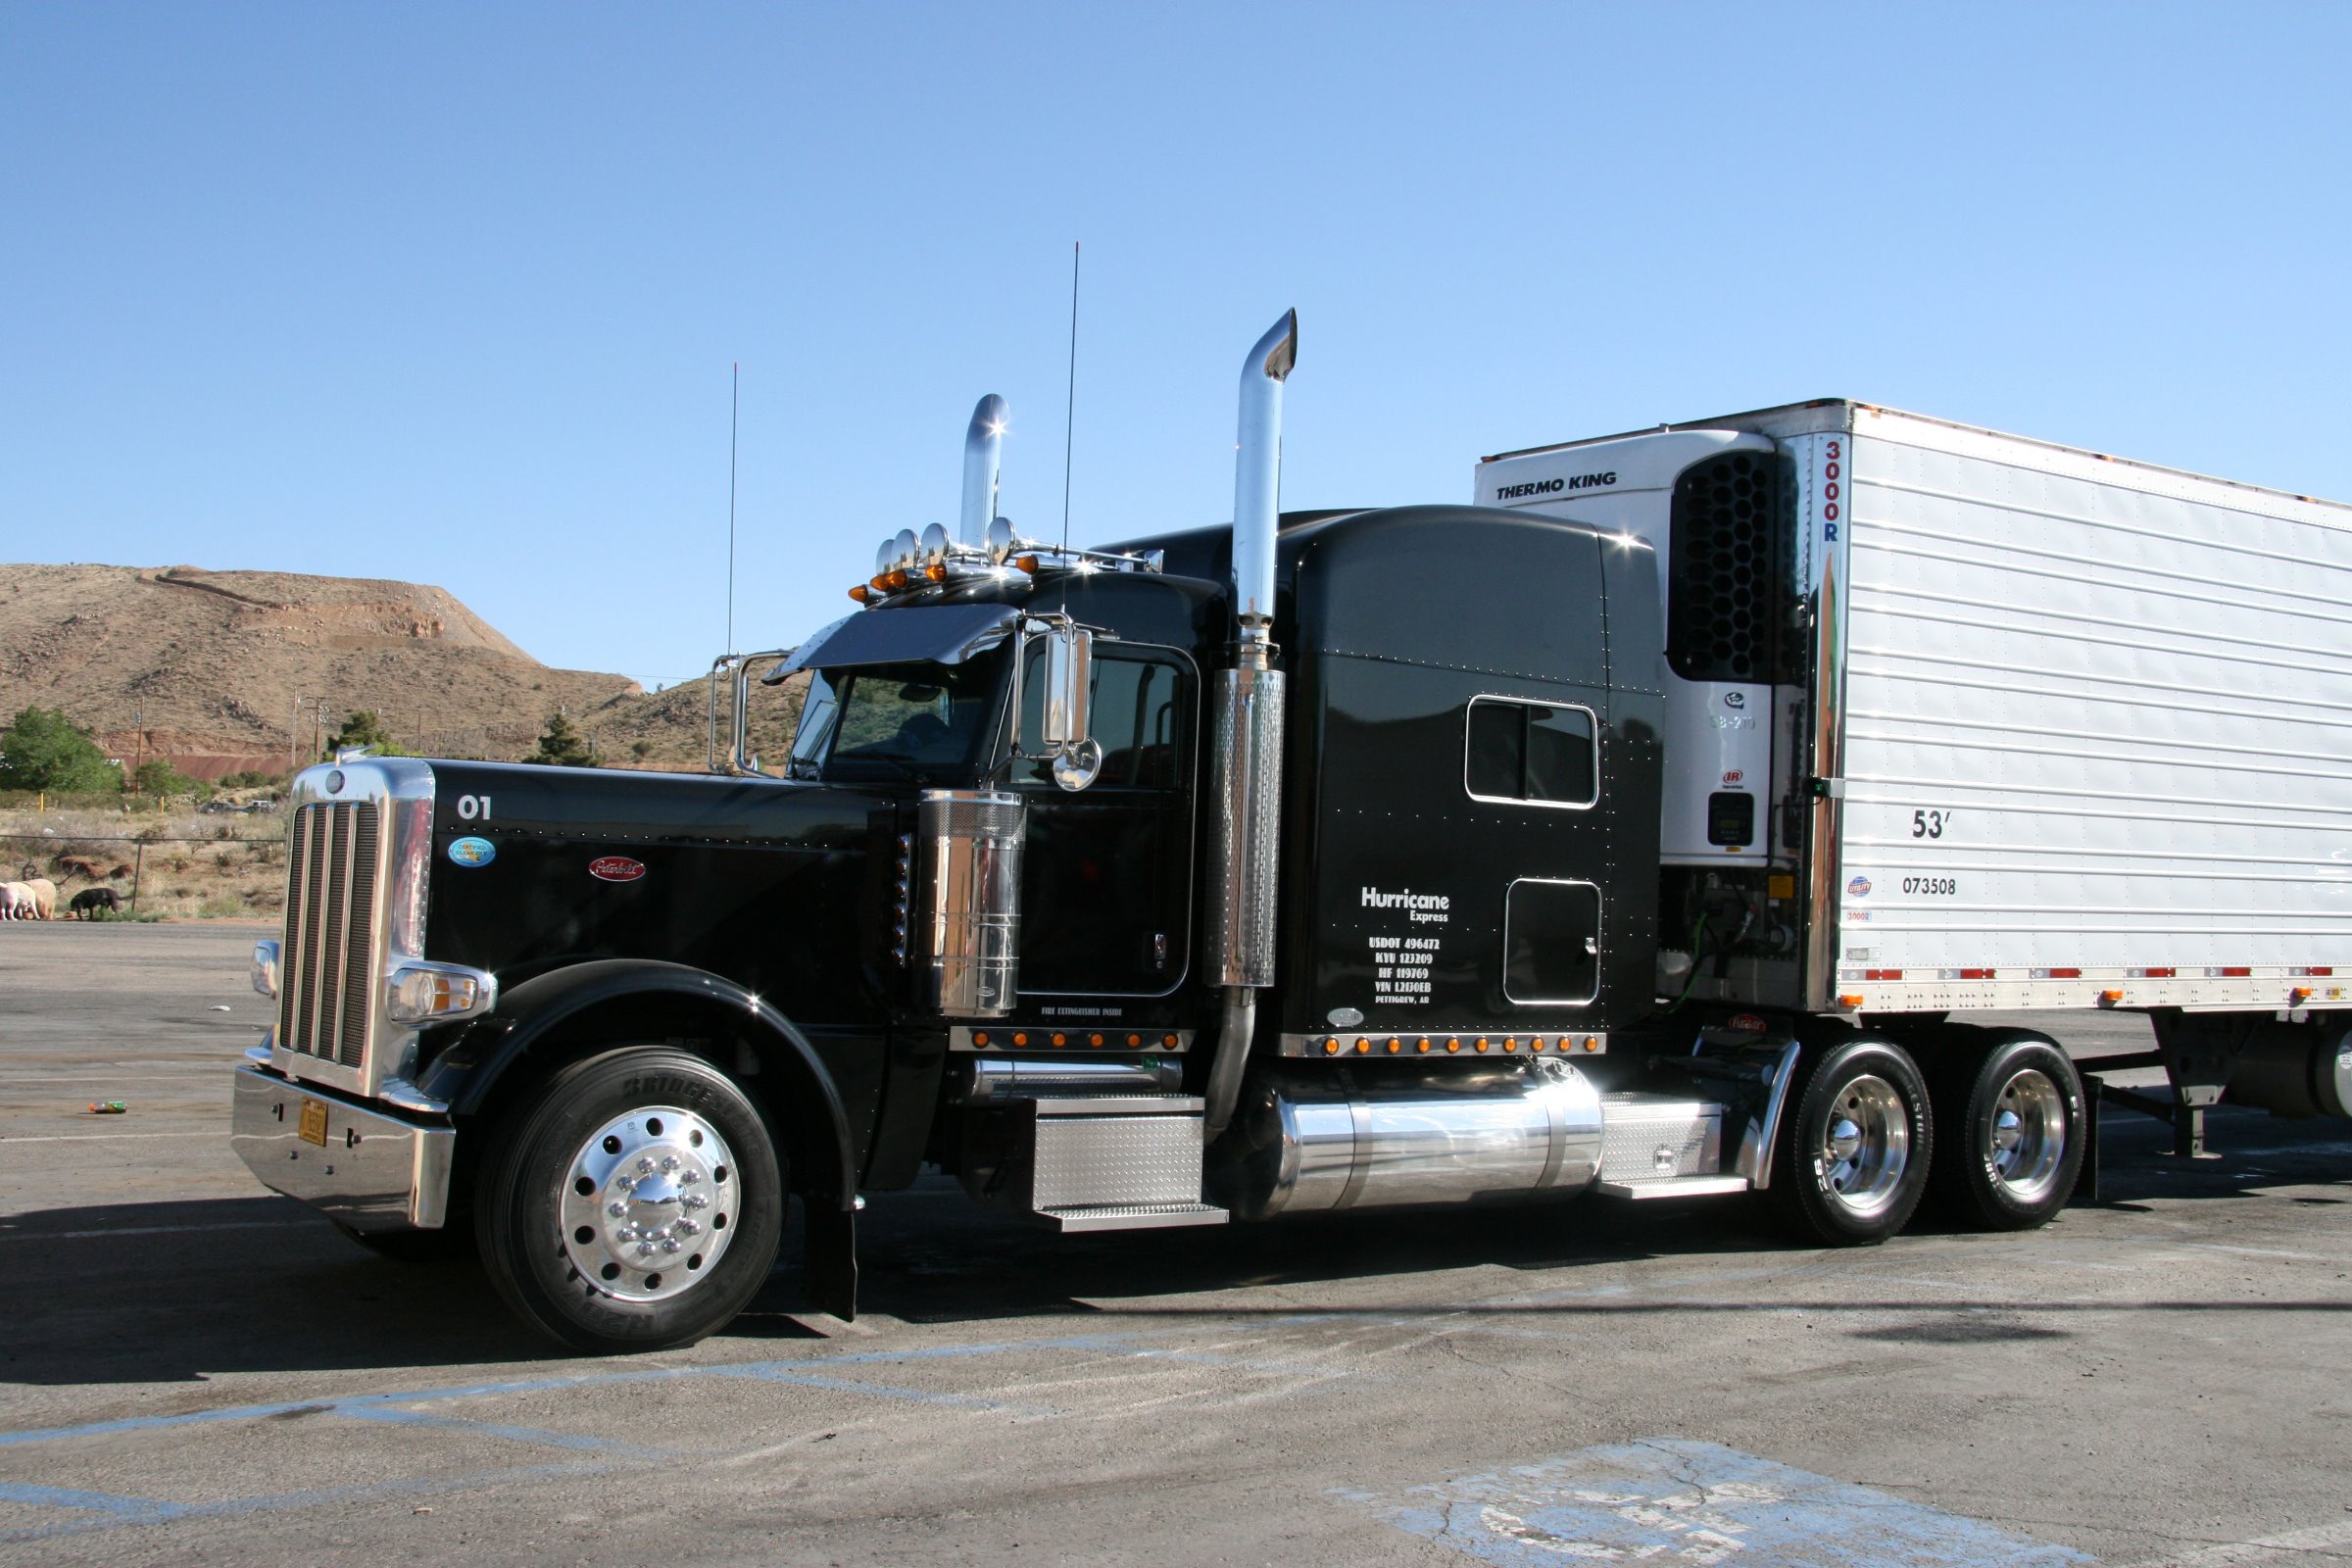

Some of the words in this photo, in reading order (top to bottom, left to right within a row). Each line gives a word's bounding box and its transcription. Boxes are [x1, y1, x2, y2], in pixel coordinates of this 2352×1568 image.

[1496, 478, 1565, 501] THERMO
[1568, 471, 1617, 490] KING
[1824, 441, 1840, 541] 3000R
[457, 795, 491, 820] 01
[1912, 809, 1950, 840] 53'
[595, 859, 638, 875] Peterbilt
[1849, 882, 1871, 894] UTILITY
[1902, 877, 1956, 895] 073508
[1361, 886, 1449, 909] Hurricane
[1409, 909, 1448, 924] Express
[1368, 937, 1401, 949] USDOT
[1404, 938, 1441, 950] 496472
[1375, 952, 1396, 963] KYU
[1399, 953, 1434, 964] 123209
[1378, 967, 1393, 978] HF
[1396, 967, 1429, 979] 119769
[1375, 981, 1392, 992] VIN
[1041, 1006, 1055, 1015] FIRE
[1057, 1006, 1101, 1016] EXTINGUISHER
[1102, 1007, 1122, 1016] INSIDE
